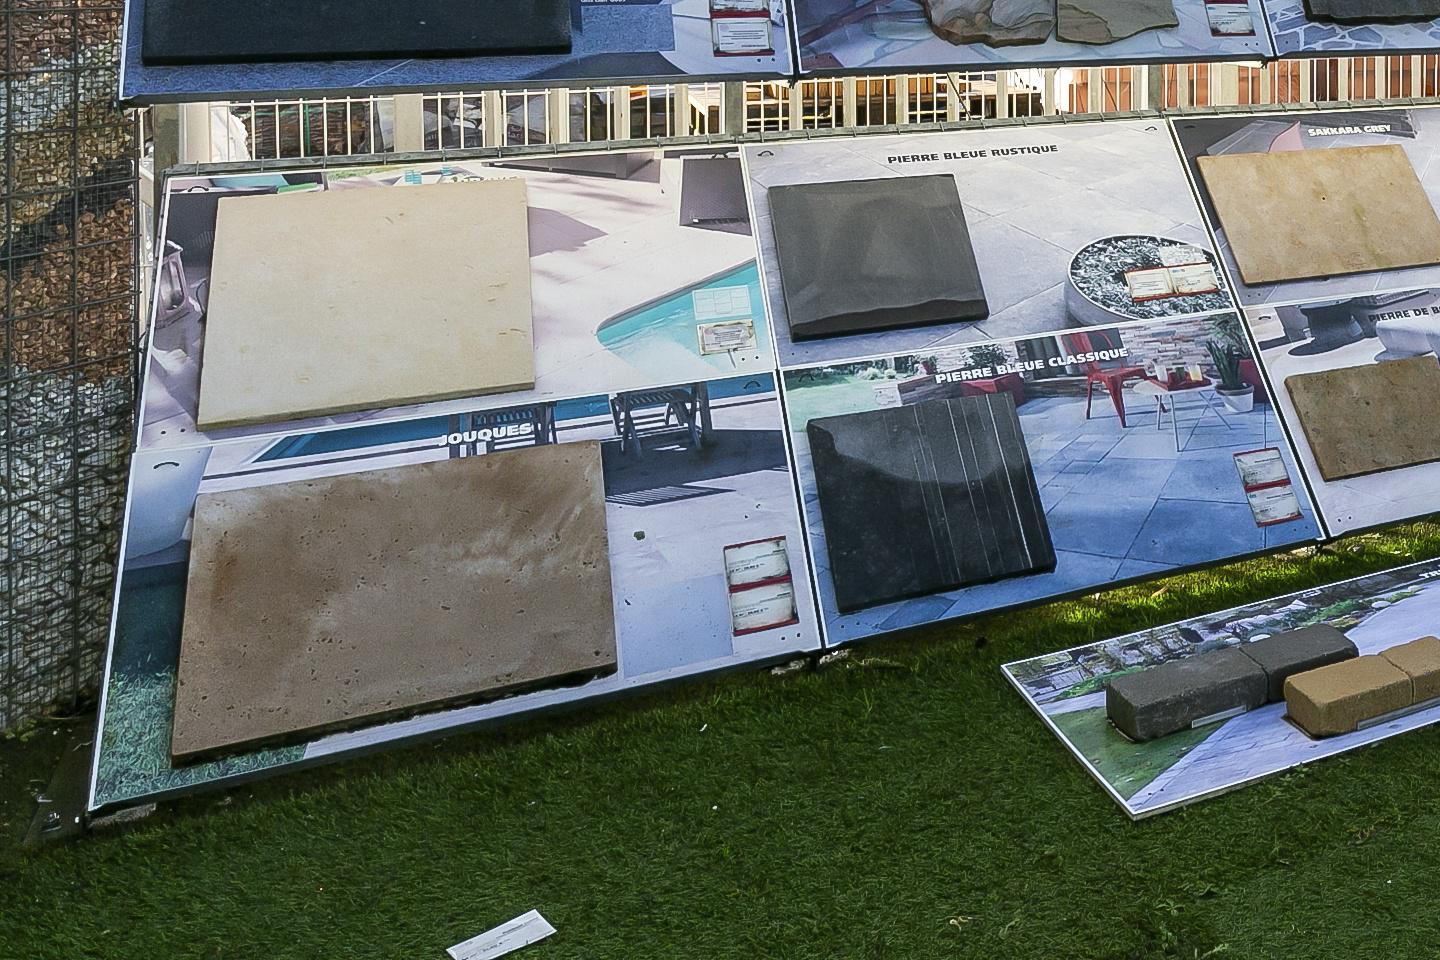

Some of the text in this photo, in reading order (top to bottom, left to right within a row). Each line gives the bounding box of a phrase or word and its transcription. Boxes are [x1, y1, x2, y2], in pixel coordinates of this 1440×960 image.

[1307, 124, 1391, 137] SAKKARA GREY
[887, 144, 1059, 164] PIERRE BLEUE RUSTIQUE
[1368, 309, 1411, 322] PIERRE
[1412, 306, 1429, 317] DE
[935, 347, 1129, 384] PIERRE BLEUE CLASSIQUE
[439, 422, 532, 447] JOUQUES
